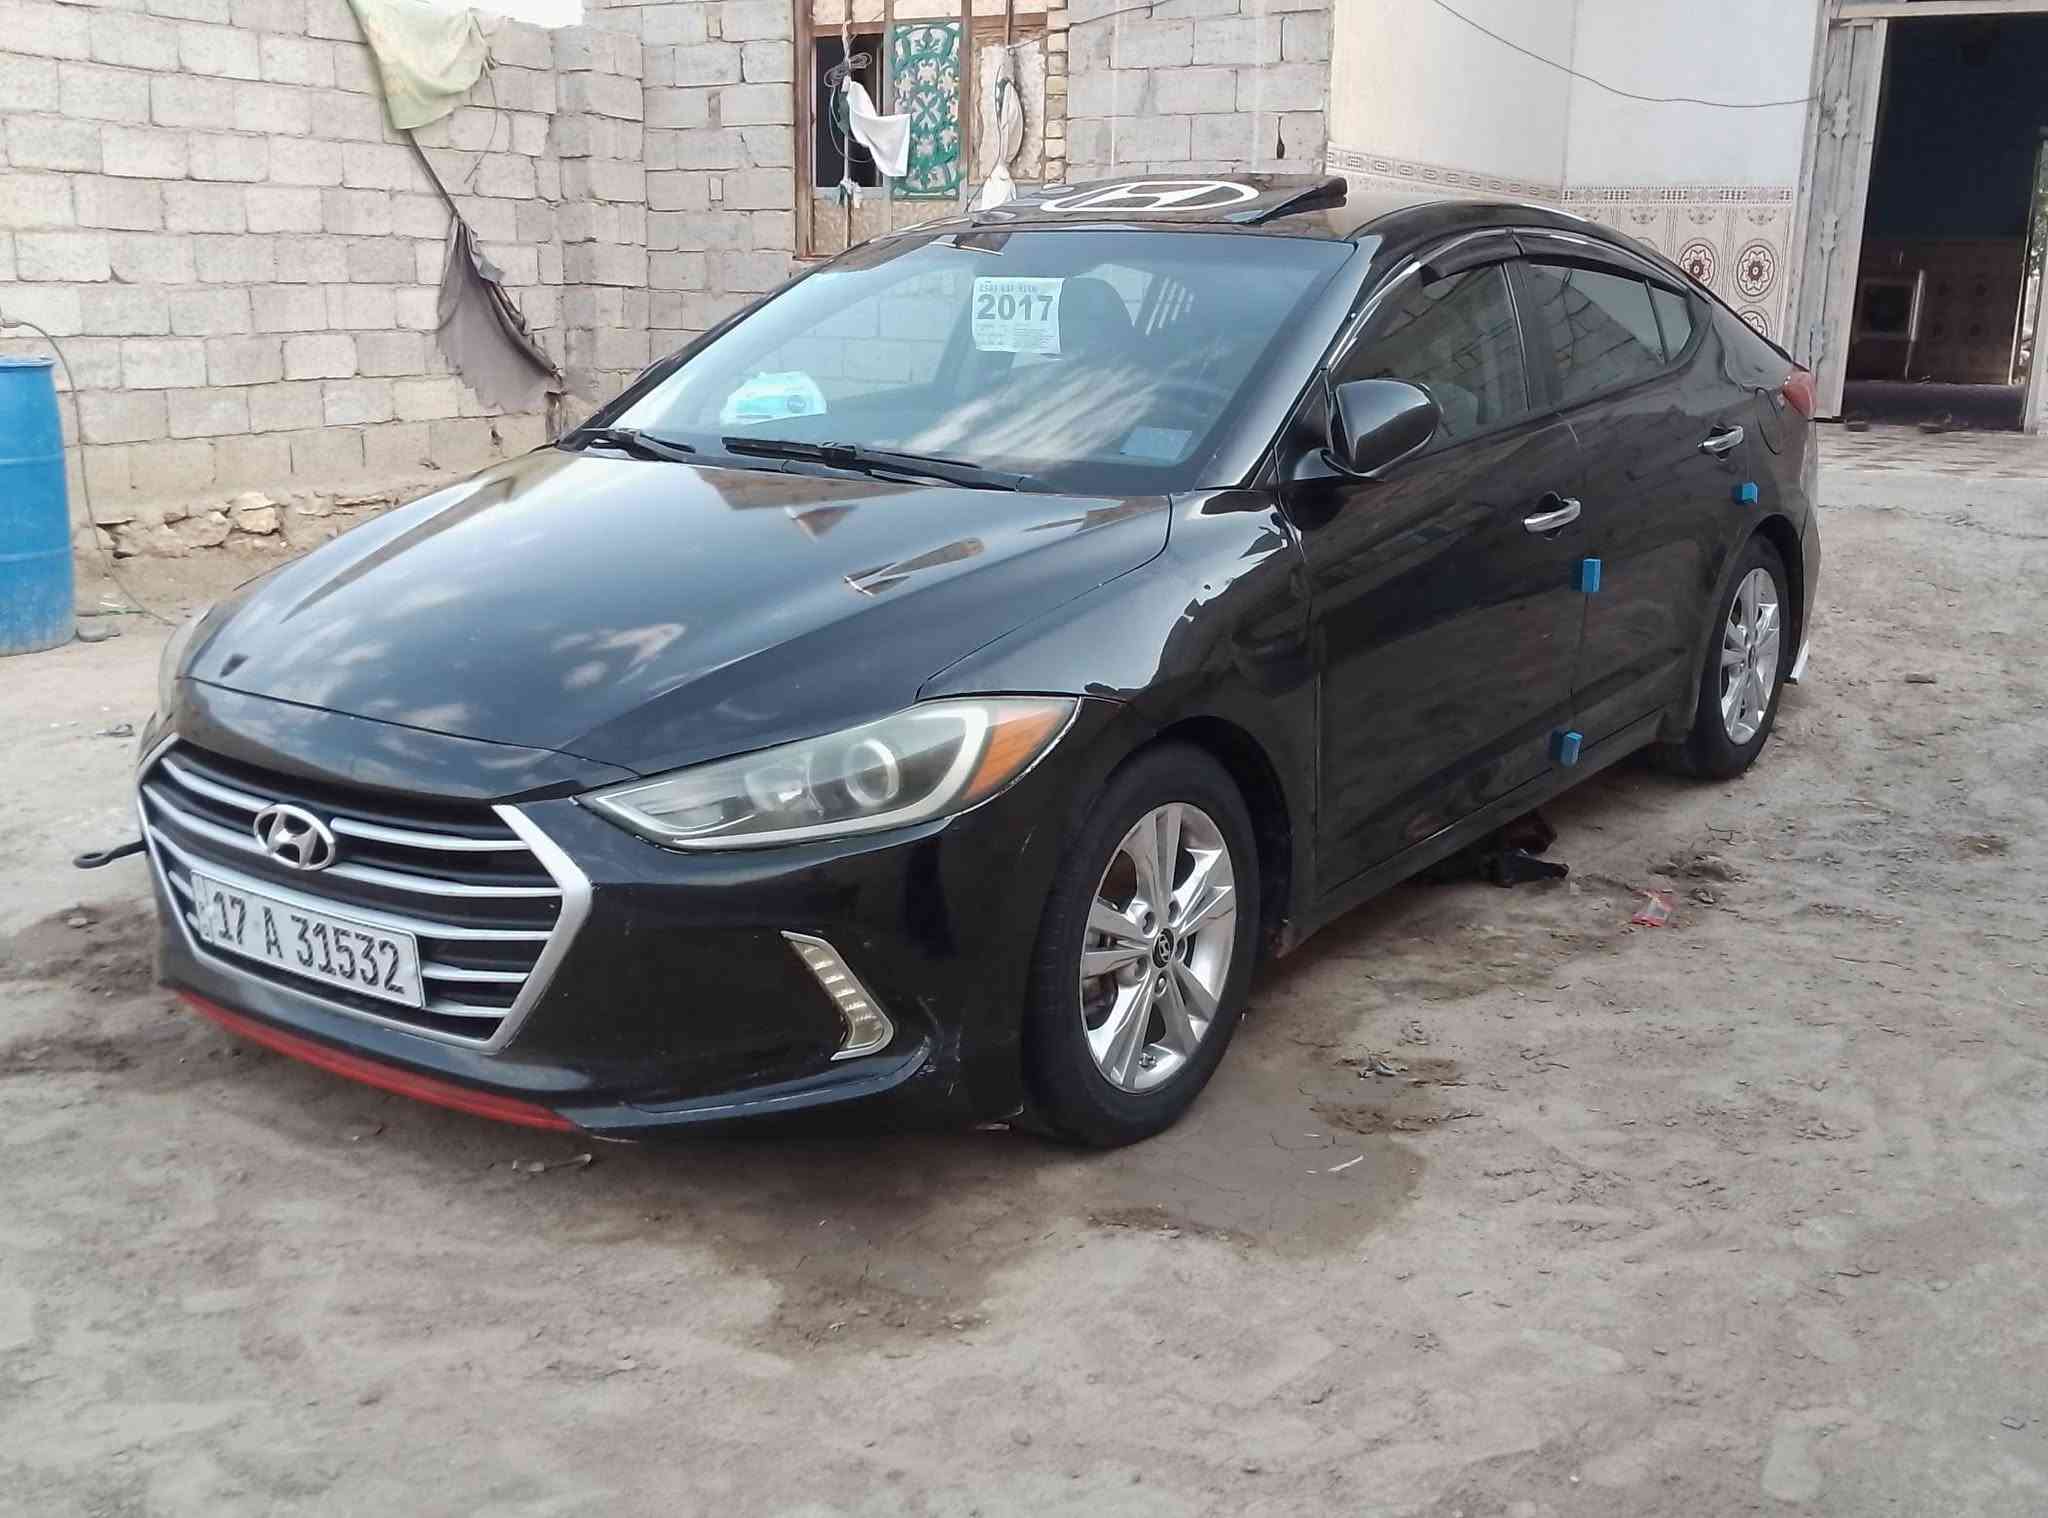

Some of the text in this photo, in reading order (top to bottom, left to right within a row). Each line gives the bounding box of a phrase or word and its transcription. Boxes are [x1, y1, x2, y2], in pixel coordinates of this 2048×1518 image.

[977, 294, 1053, 320] 2017
[214, 892, 246, 945] 17
[263, 906, 283, 959] A
[292, 915, 405, 994] 31532
